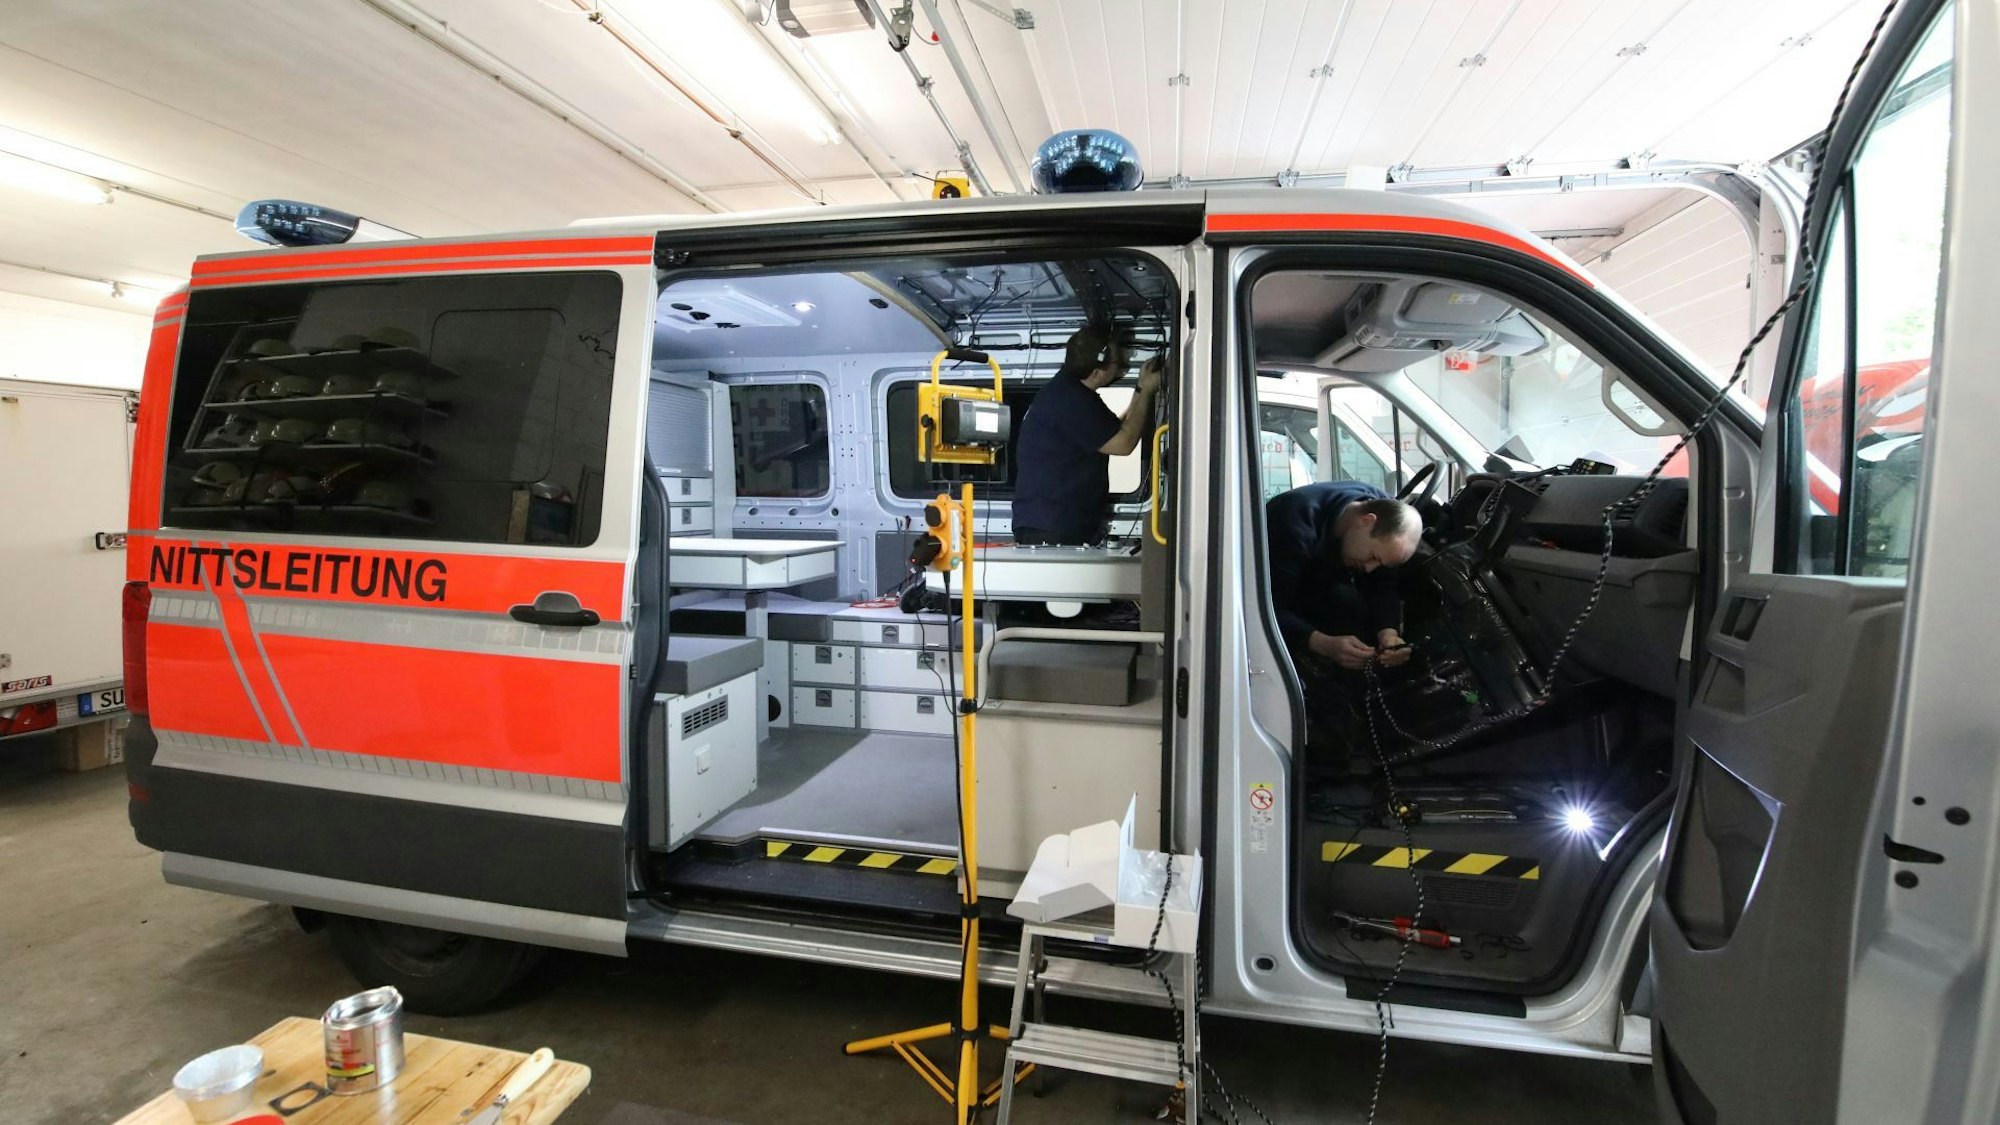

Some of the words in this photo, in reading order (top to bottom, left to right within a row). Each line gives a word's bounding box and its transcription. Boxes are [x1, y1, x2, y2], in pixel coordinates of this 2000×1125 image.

[150, 545, 447, 602] NITTSLEITUNG
[5, 676, 48, 693] saris
[101, 689, 124, 708] SU
